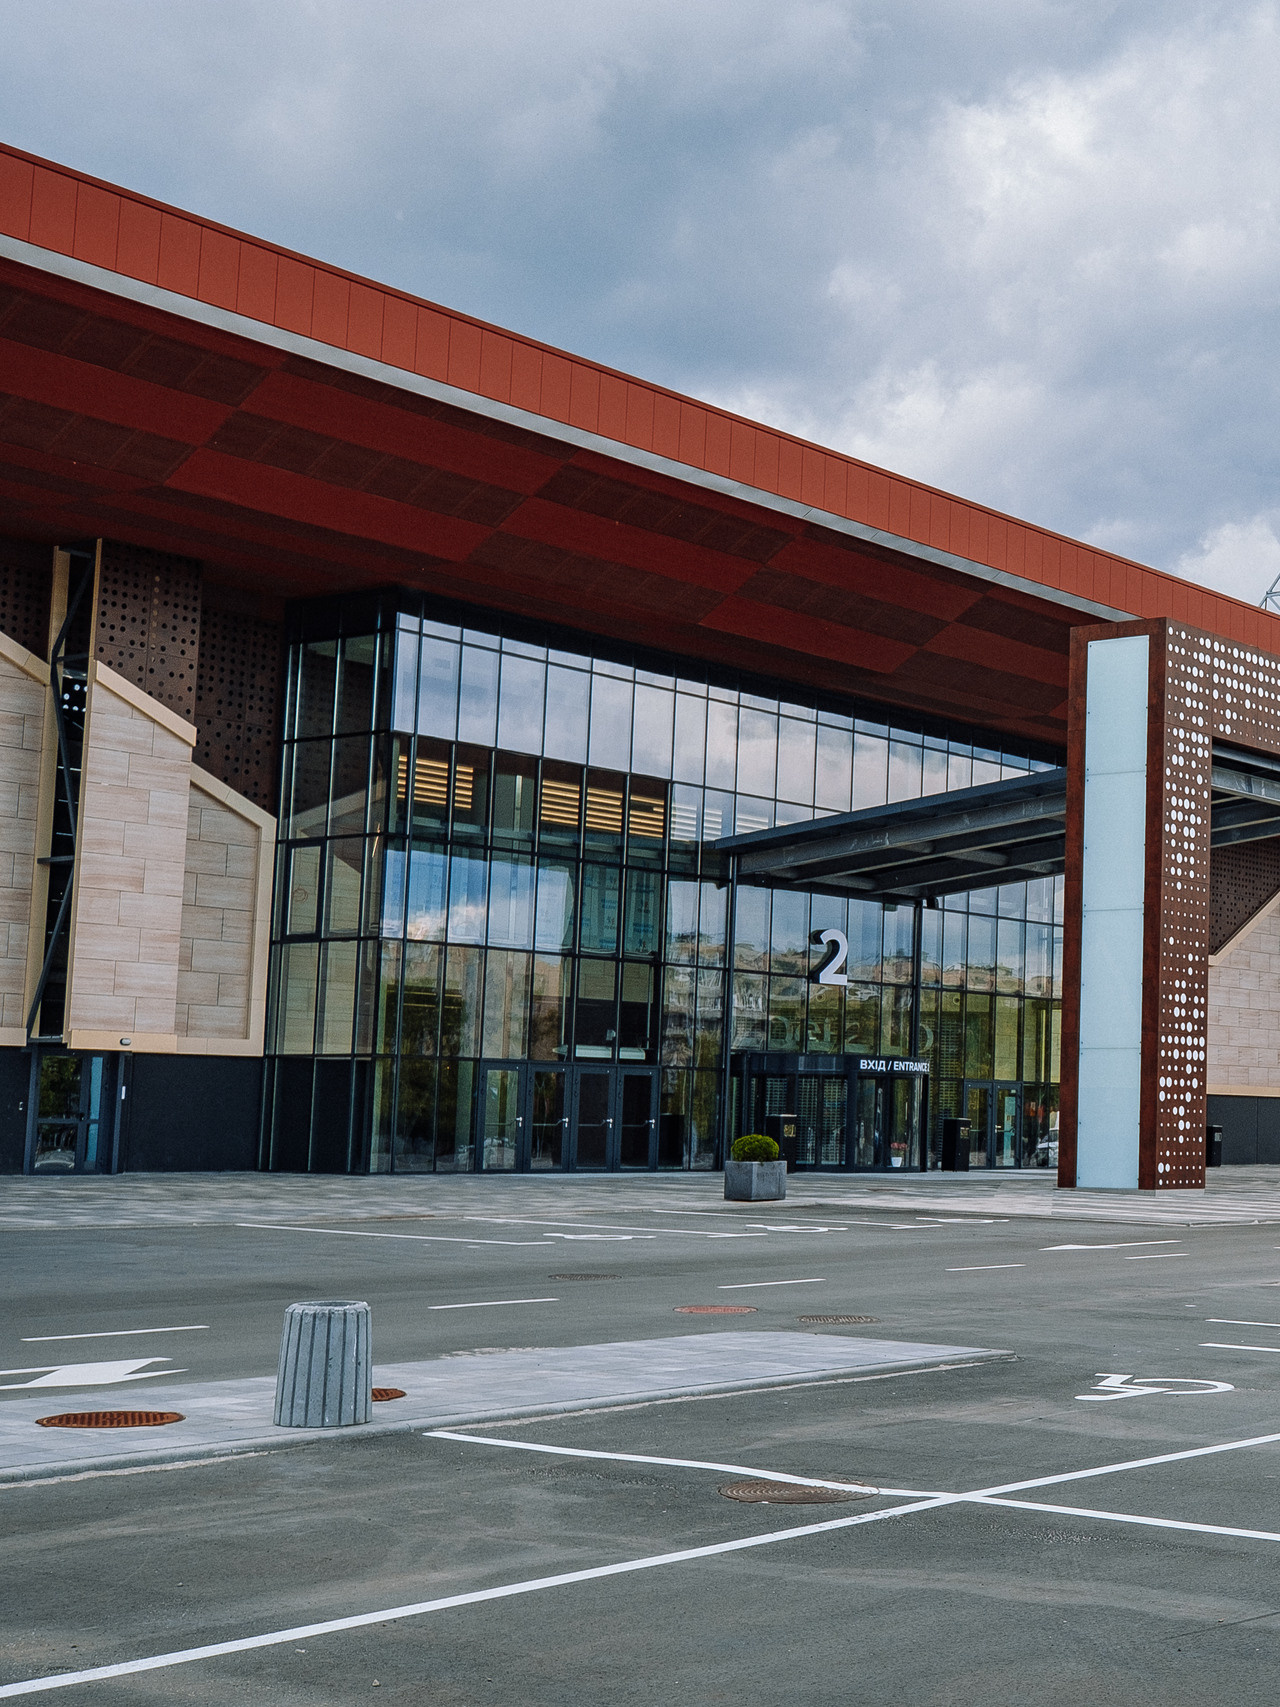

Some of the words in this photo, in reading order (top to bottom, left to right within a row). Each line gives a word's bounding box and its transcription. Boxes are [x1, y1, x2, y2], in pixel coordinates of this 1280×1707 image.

[816, 928, 849, 986] 2
[860, 1059, 886, 1072] ВХІД
[887, 1060, 893, 1071] /
[893, 1060, 927, 1072] ENTRANCE
